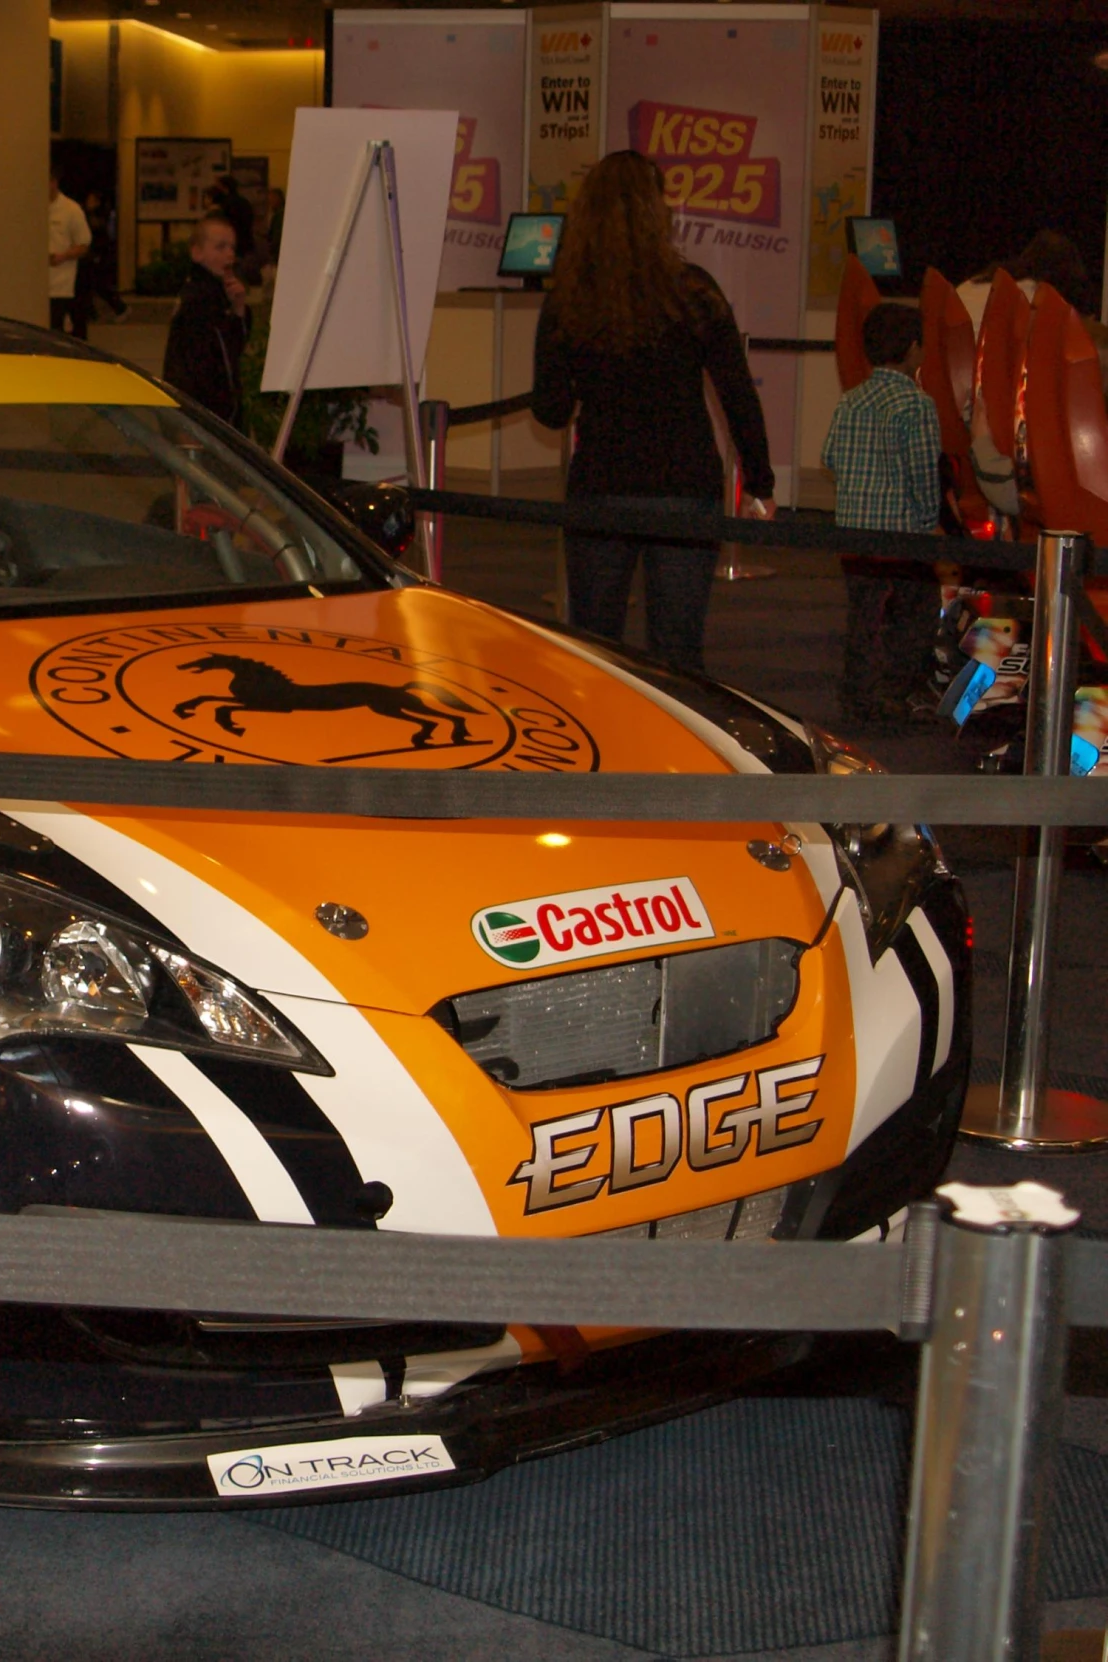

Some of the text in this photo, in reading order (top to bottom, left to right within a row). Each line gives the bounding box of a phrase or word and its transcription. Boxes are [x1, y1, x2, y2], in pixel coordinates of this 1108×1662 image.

[540, 76, 591, 90] Enter to
[820, 76, 862, 91] Enter to
[542, 90, 590, 114] WIN
[820, 91, 861, 115] WIN
[663, 162, 767, 215] 92.5
[711, 228, 790, 255] MUSIC
[536, 885, 702, 952] Castrol
[507, 1053, 827, 1216] EDGE
[225, 1446, 440, 1489] ON TRACK
[270, 1474, 339, 1487] FINANCIAL
[339, 1463, 415, 1479] SOLUTIONS
